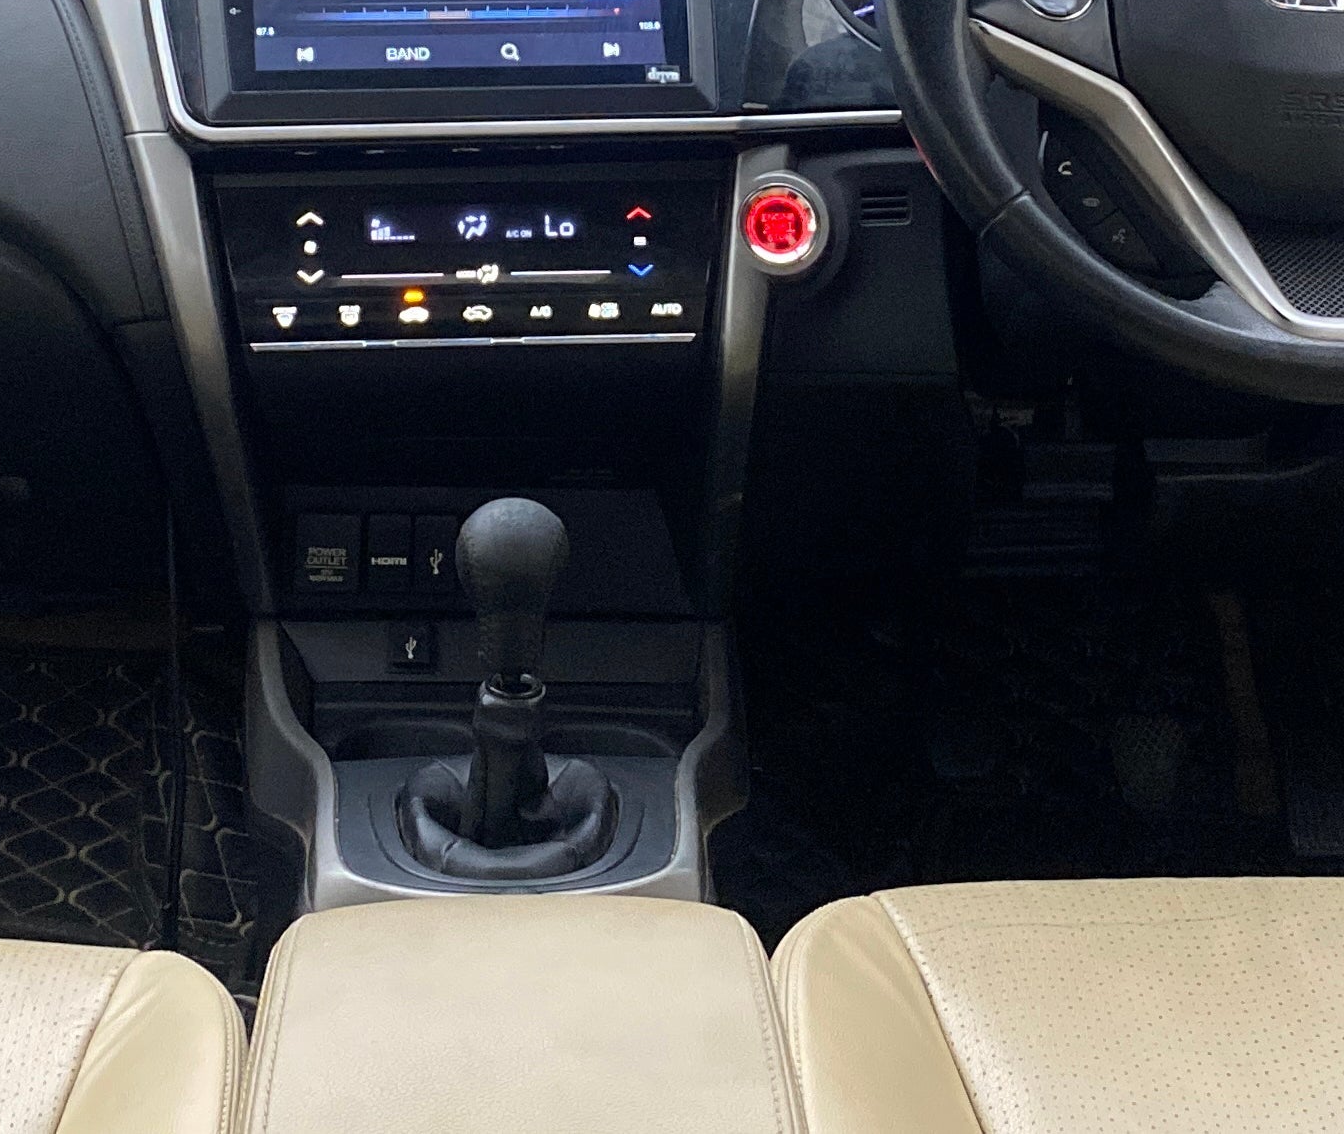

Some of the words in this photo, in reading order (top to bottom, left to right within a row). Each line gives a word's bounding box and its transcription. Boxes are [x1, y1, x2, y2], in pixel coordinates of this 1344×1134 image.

[385, 47, 431, 61] BAND
[544, 214, 575, 237] Lo
[650, 302, 683, 316] AUTO
[307, 547, 347, 556] POWER
[306, 556, 348, 565] OUTLET
